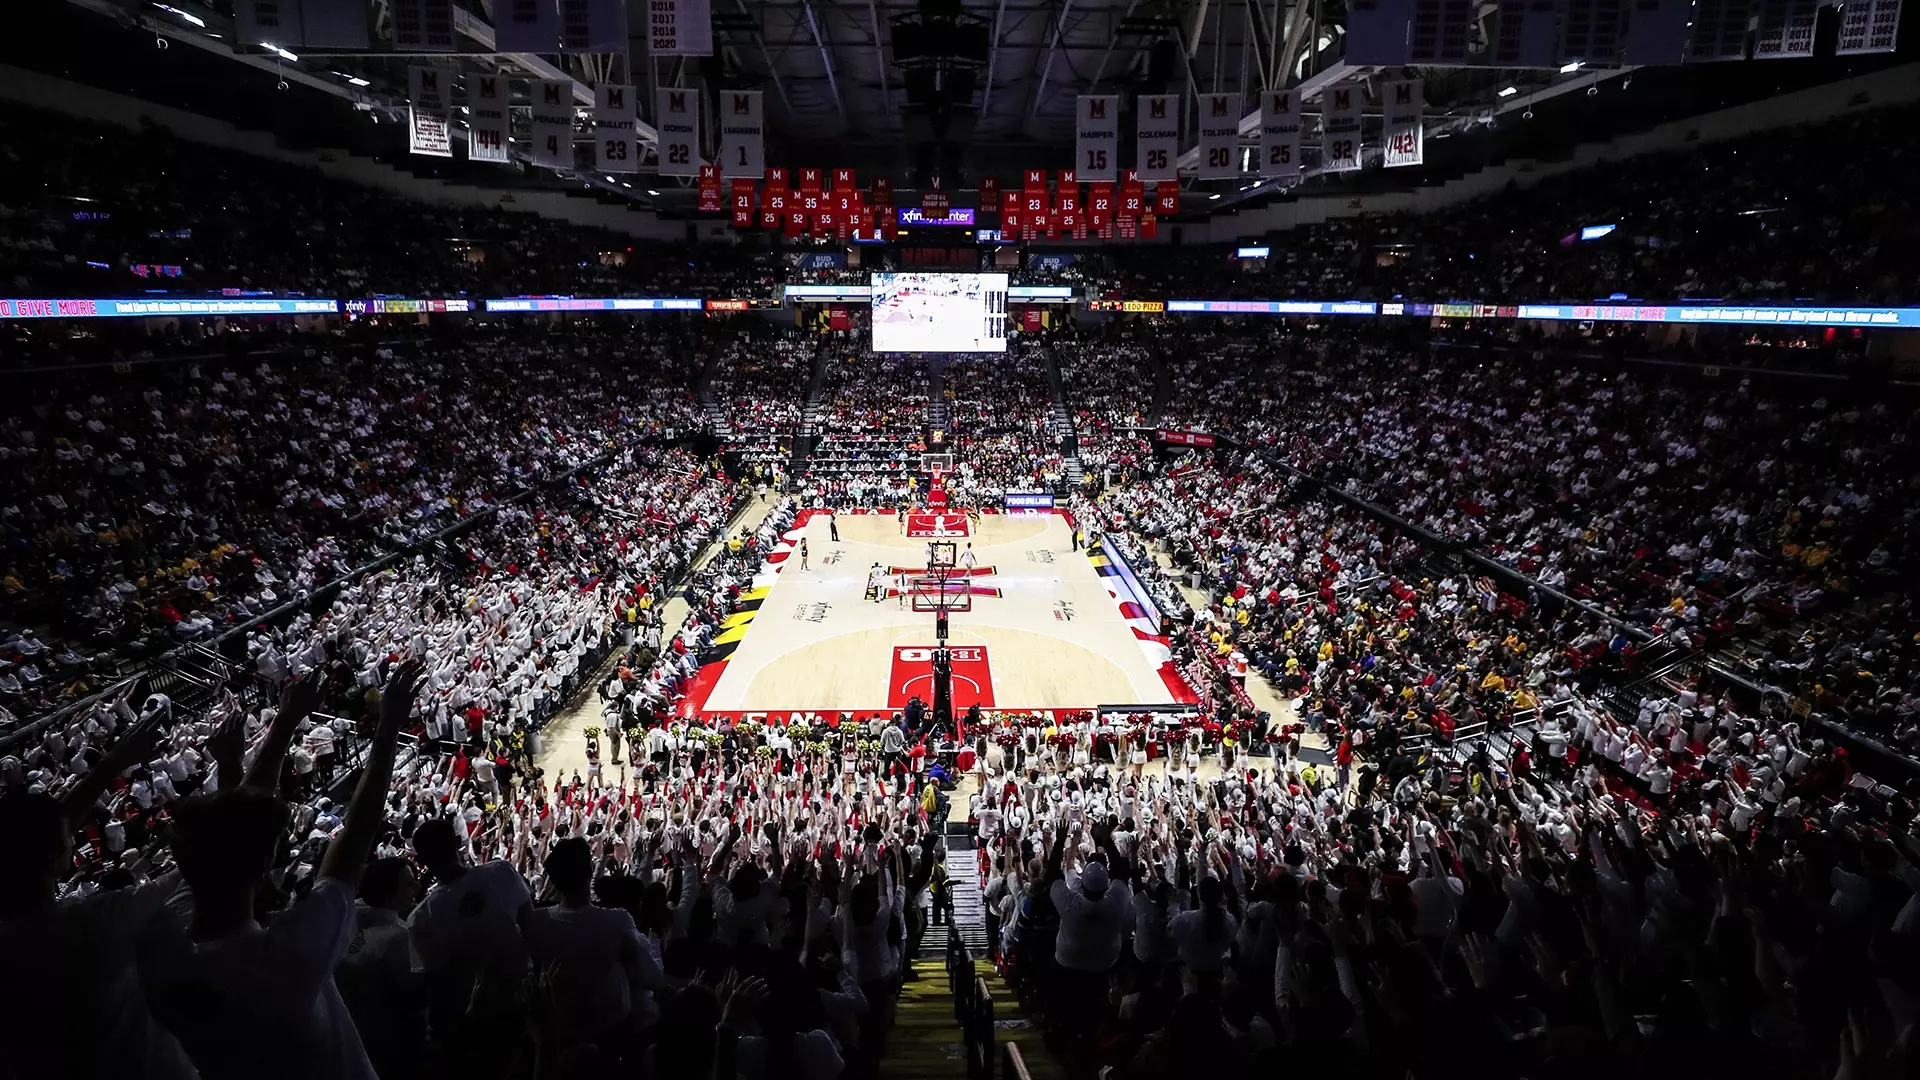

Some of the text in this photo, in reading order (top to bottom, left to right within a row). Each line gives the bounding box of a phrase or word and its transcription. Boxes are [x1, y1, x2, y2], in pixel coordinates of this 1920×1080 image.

[652, 14, 675, 24] 2017
[654, 40, 676, 48] 2020
[544, 84, 560, 104] M
[608, 89, 622, 109] M
[1396, 84, 1410, 104] M
[670, 92, 685, 112] M
[734, 95, 748, 114] M
[1274, 94, 1288, 114] M
[1335, 90, 1349, 110] M
[1090, 100, 1104, 118] M
[1151, 100, 1165, 118] M
[1212, 97, 1226, 116] M
[598, 120, 633, 129] BULLETT
[1203, 129, 1236, 137] TOLIVER
[1264, 126, 1298, 134] THOMAS
[480, 130, 500, 150] 44
[1394, 135, 1412, 153] 42
[548, 136, 557, 155] 4
[606, 140, 626, 160] 23
[1332, 140, 1352, 159] 32
[670, 144, 688, 164] 22
[739, 146, 747, 165] 1
[1210, 148, 1229, 168] 20
[1271, 145, 1290, 164] 25
[1088, 150, 1106, 169] 15
[1148, 150, 1167, 169] 25
[705, 169, 713, 178] M
[772, 170, 780, 180] M
[806, 171, 814, 180] M
[840, 172, 848, 180] M
[1031, 172, 1039, 182] M
[1064, 172, 1072, 182] M
[1130, 172, 1137, 180] M
[822, 192, 829, 200] M
[1010, 194, 1016, 202] M
[738, 196, 748, 207] 21
[772, 198, 782, 208] 25
[806, 198, 816, 208] 35
[842, 198, 848, 208] 3
[1029, 200, 1040, 210] 23
[1062, 200, 1074, 210] 15
[1096, 200, 1107, 210] 22
[1127, 199, 1138, 209] 32
[1162, 198, 1174, 208] 42
[736, 212, 746, 221] 34
[765, 214, 774, 222] 25
[793, 214, 803, 223] 52
[822, 215, 830, 224] 55
[850, 215, 858, 224] 15
[1008, 216, 1016, 225] 41
[1036, 216, 1045, 225] 54
[1064, 216, 1074, 224] 25
[1094, 216, 1100, 224] 6
[16, 300, 53, 316] GIVE
[58, 300, 97, 316] MORE
[345, 300, 366, 313] xfinity
[1601, 307, 1612, 319] TO
[1614, 307, 1636, 320] GIVE
[1639, 307, 1666, 320] MORE
